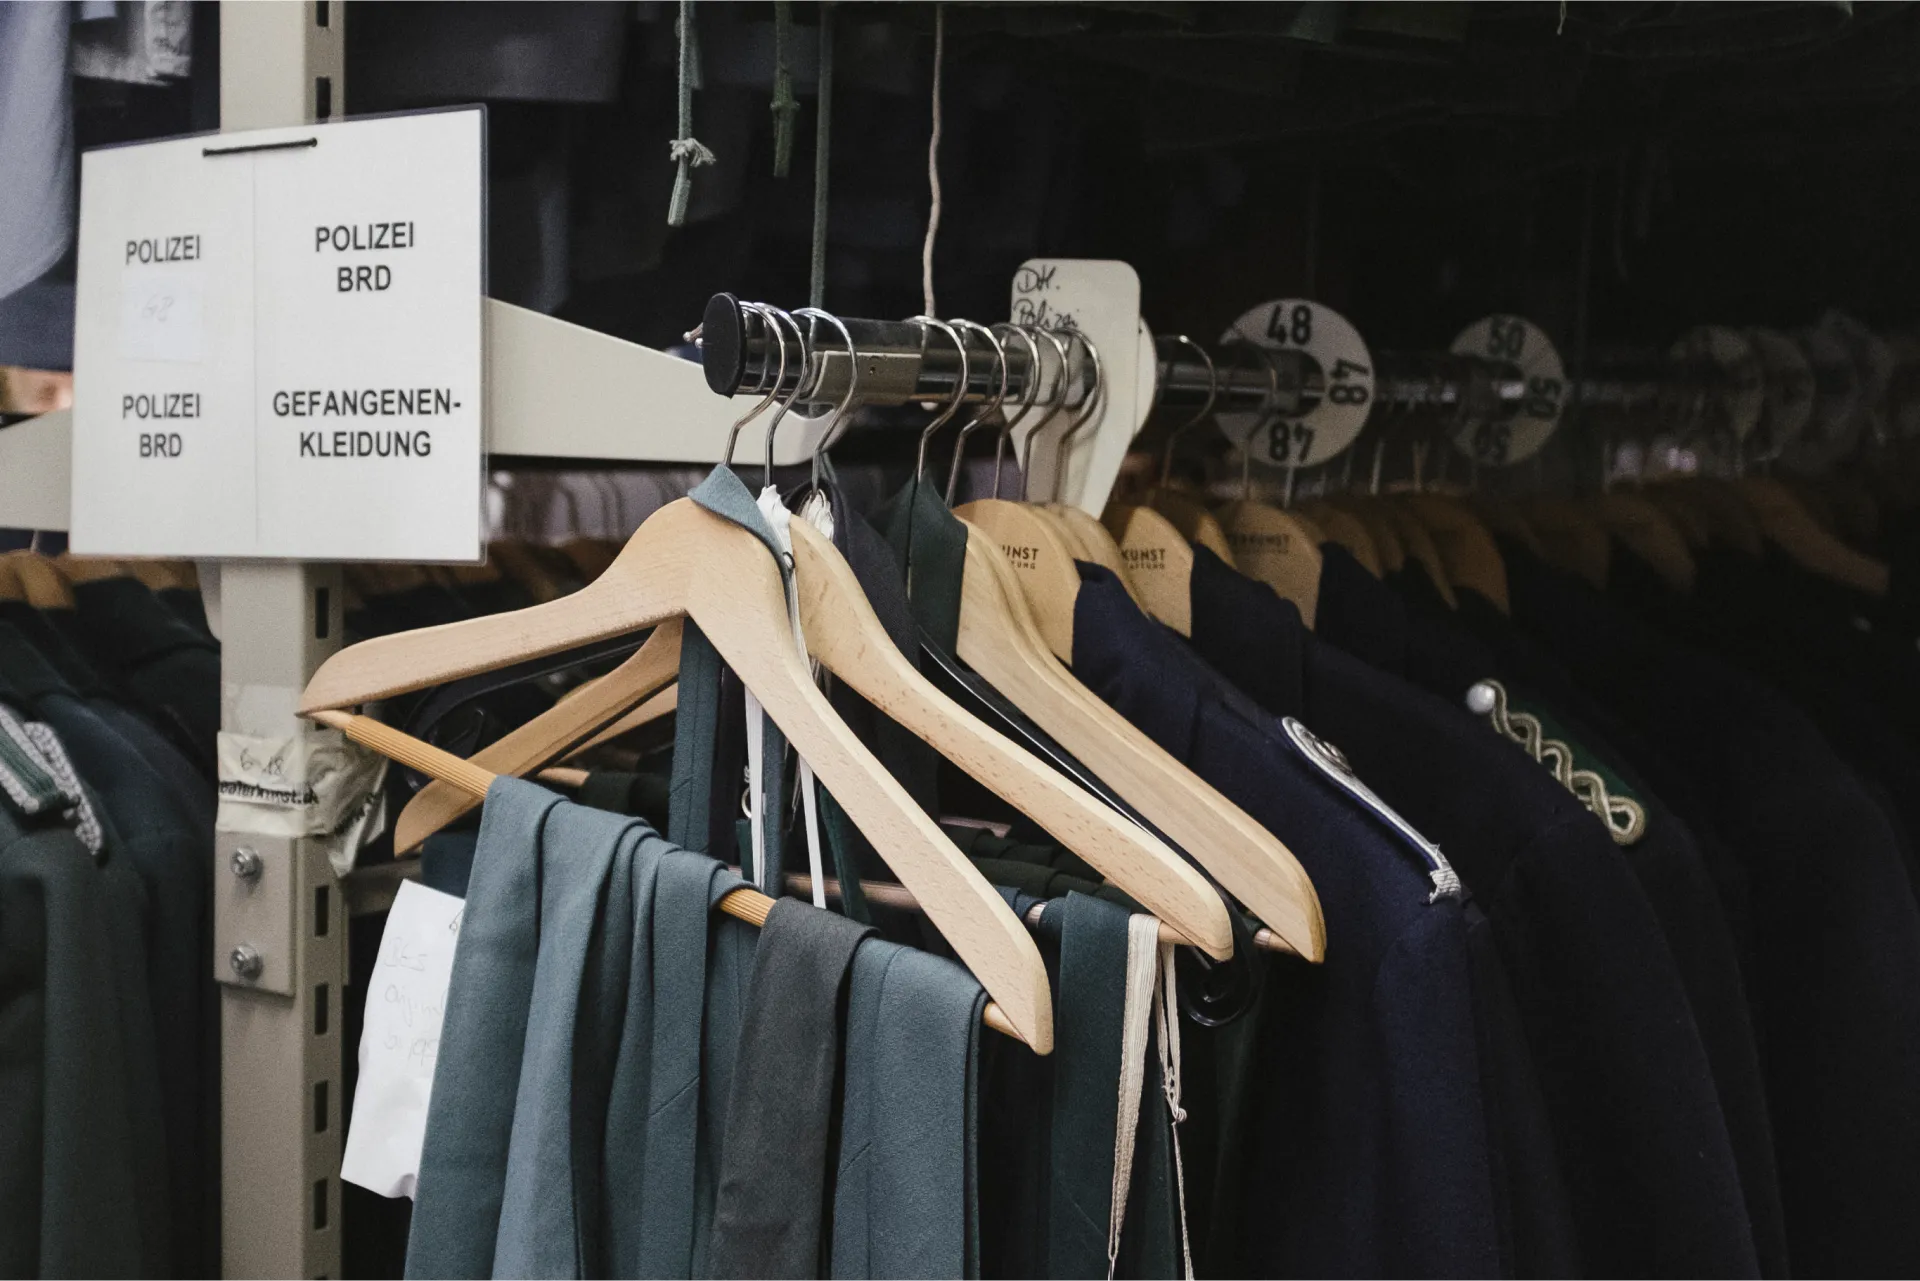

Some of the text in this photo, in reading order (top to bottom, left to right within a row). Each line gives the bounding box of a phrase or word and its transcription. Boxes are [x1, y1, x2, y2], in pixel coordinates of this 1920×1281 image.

[125, 234, 201, 265] POLIZEI
[315, 221, 415, 253] POLIZEI
[337, 265, 392, 293] BRD
[1266, 303, 1312, 347] 48
[1328, 359, 1370, 405] 48
[122, 393, 201, 419] POLIZEI
[272, 388, 462, 417] GEFANGENEN-
[139, 432, 182, 458] BRD
[299, 430, 431, 457] KLEIDUNG
[1268, 421, 1314, 463] 48
[1001, 544, 1040, 561] UNST
